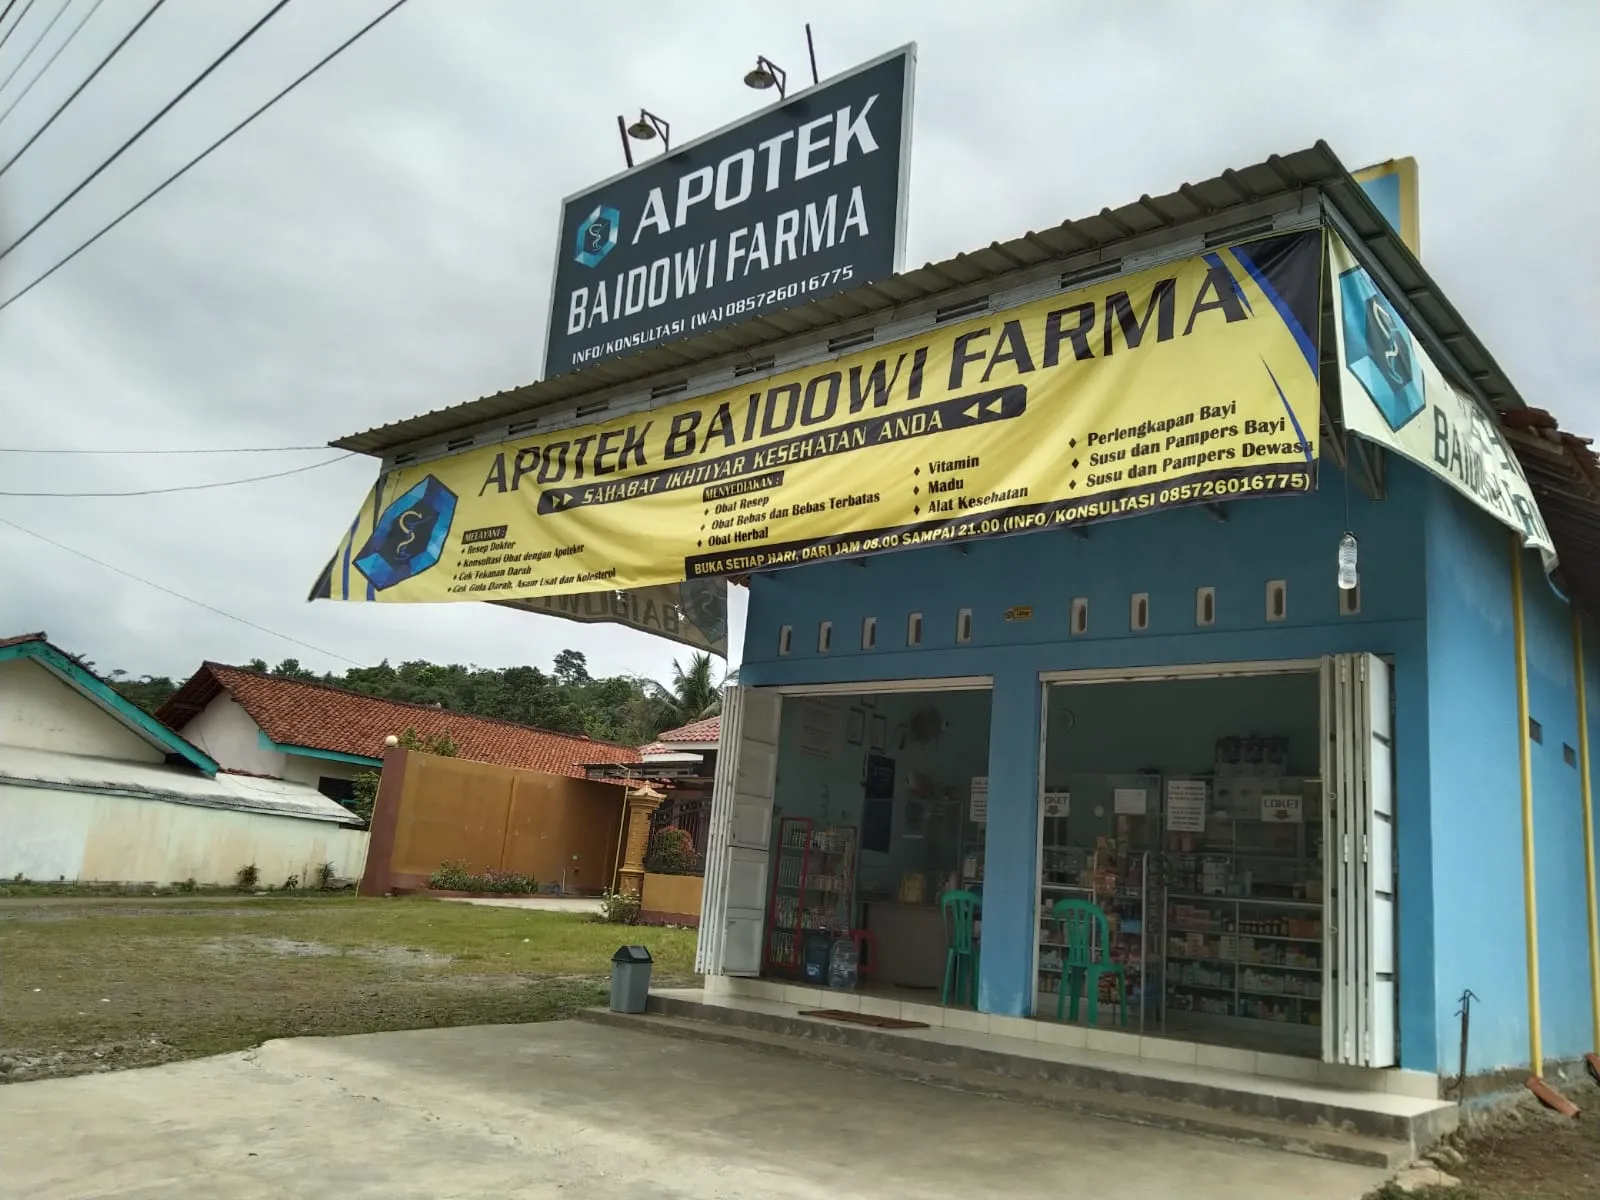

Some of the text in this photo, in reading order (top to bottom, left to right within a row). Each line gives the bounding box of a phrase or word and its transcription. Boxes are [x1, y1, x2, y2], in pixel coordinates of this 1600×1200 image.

[631, 93, 880, 246] APOTEK
[567, 185, 869, 335] BAIDOWI FARMA
[478, 265, 1249, 497] APOTEK BAIDOWI FARMA
[1088, 401, 1237, 447] Perlengkapan Bayi
[1089, 417, 1286, 467] Susu dan Pampers Bayi
[581, 408, 944, 505] SAHABAT IKHTIYAR KESEHATAN ANDA
[929, 456, 980, 475] Vitamin
[1086, 441, 1313, 488] Susu dan Pampers Dewasa
[705, 476, 773, 500] MENYEDIAKAN
[928, 477, 964, 494] Madu
[711, 492, 881, 531] Obat Bebas dan Bebas Terbatas
[715, 496, 770, 515] Obat Resep
[928, 487, 1028, 514] Alat Kesehatan
[464, 528, 501, 542] MELAYANI
[694, 559, 723, 575] BUKA
[726, 555, 765, 570] SETIAP
[768, 550, 799, 565] HARI,
[802, 545, 832, 559] DARI
[835, 541, 860, 556] JAM
[862, 534, 899, 551] 08.00
[902, 525, 955, 545] SAMPAI
[958, 518, 1000, 537] 21.00
[1159, 473, 1311, 504] 085726016775)
[708, 527, 769, 547] Obat Herbal
[463, 544, 585, 568] Konsultasi Obat dengan Apoteker
[467, 541, 516, 555] Resep Dokter
[452, 584, 466, 593] Cek
[469, 583, 486, 592] Gula
[517, 579, 538, 588] Asam
[559, 575, 574, 584] dan
[576, 568, 616, 583] Kolesterol
[458, 566, 531, 580] Cek Tekanan Darah
